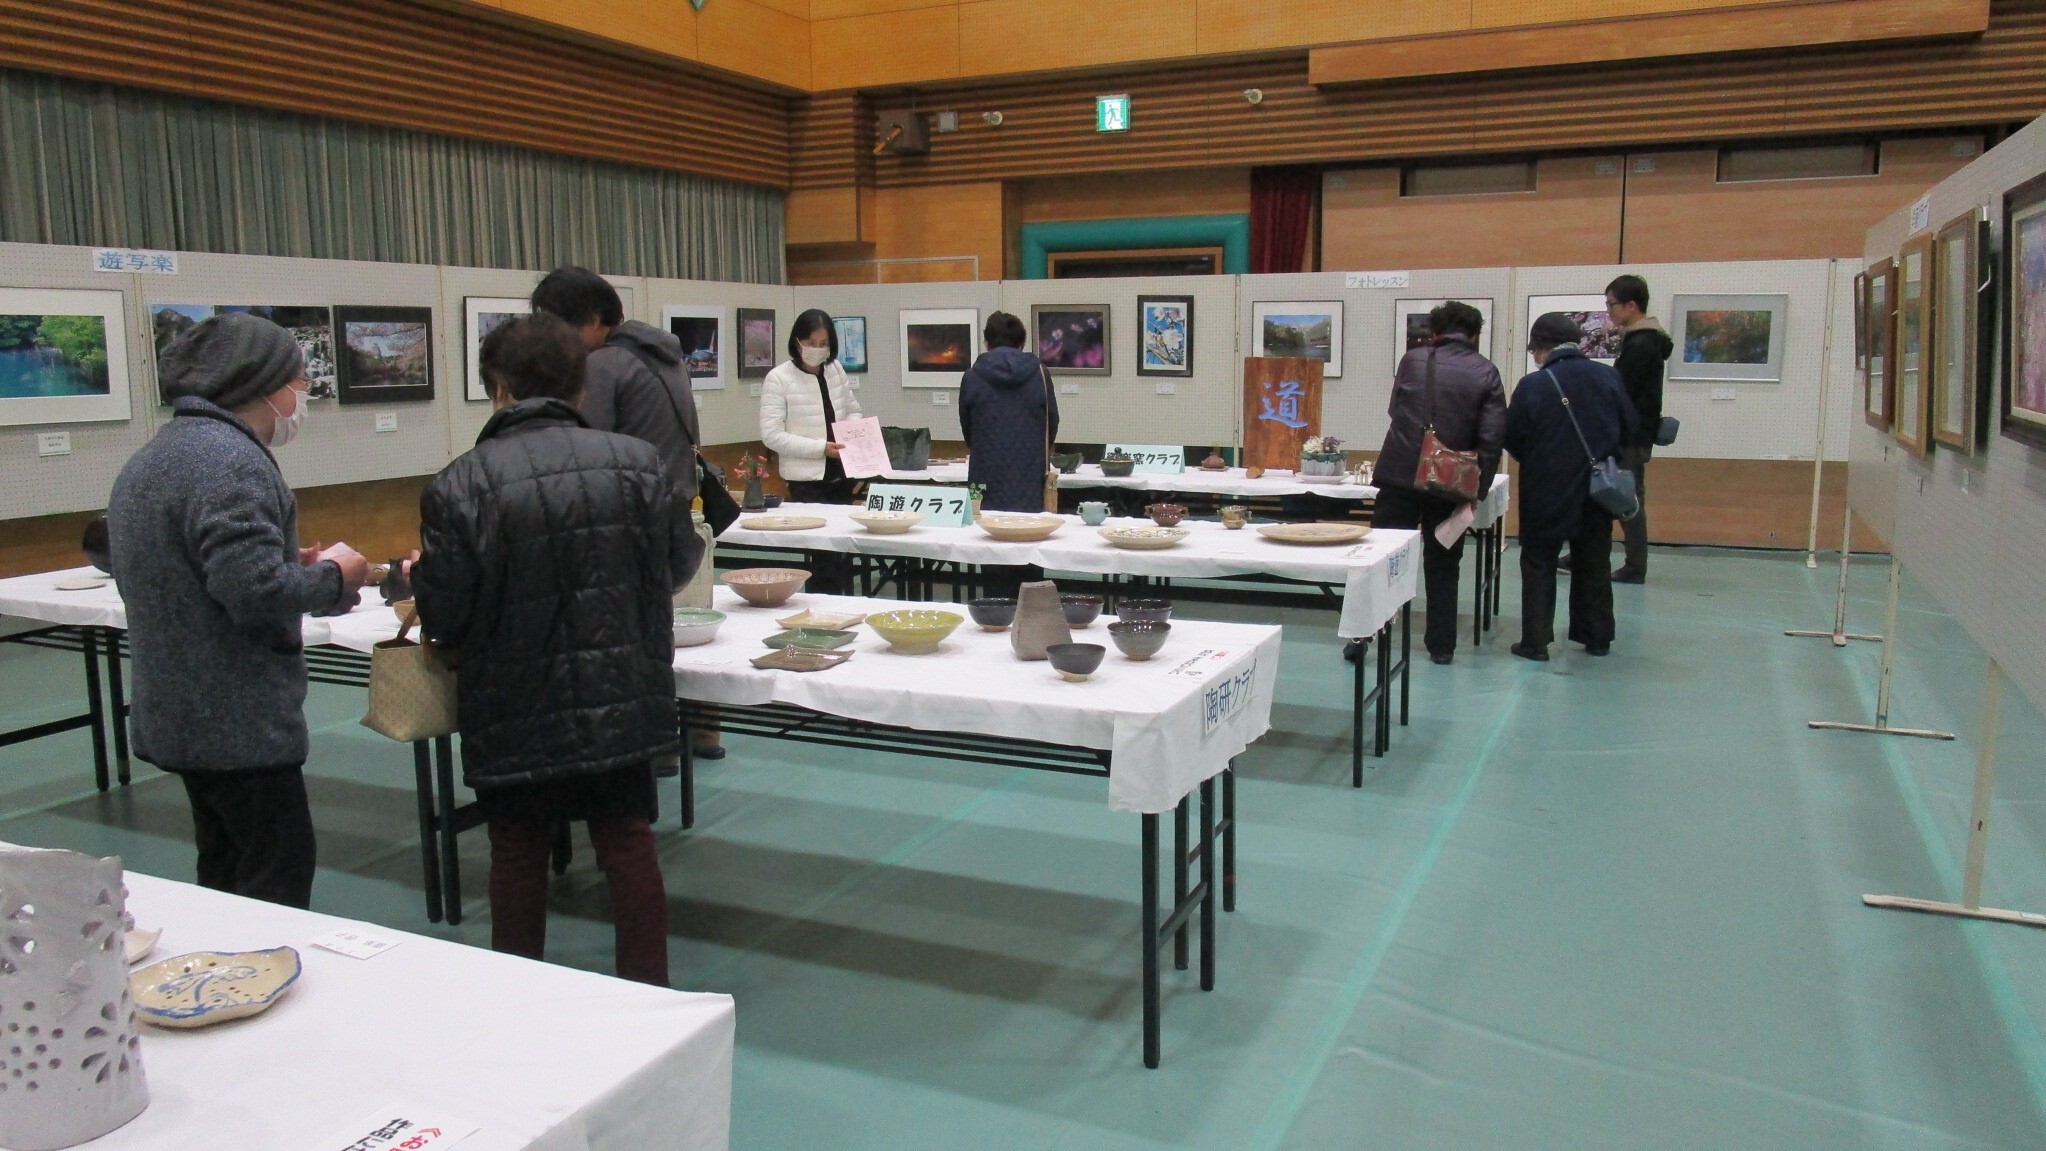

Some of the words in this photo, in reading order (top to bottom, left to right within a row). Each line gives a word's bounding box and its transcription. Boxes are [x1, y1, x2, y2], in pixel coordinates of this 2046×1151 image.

[98, 250, 174, 272] 遊写楽
[1348, 275, 1408, 288] フォトレッスン
[1258, 380, 1309, 428] 道
[1106, 451, 1181, 466] 窯クラブ
[867, 494, 964, 515] 陶遊クラブ
